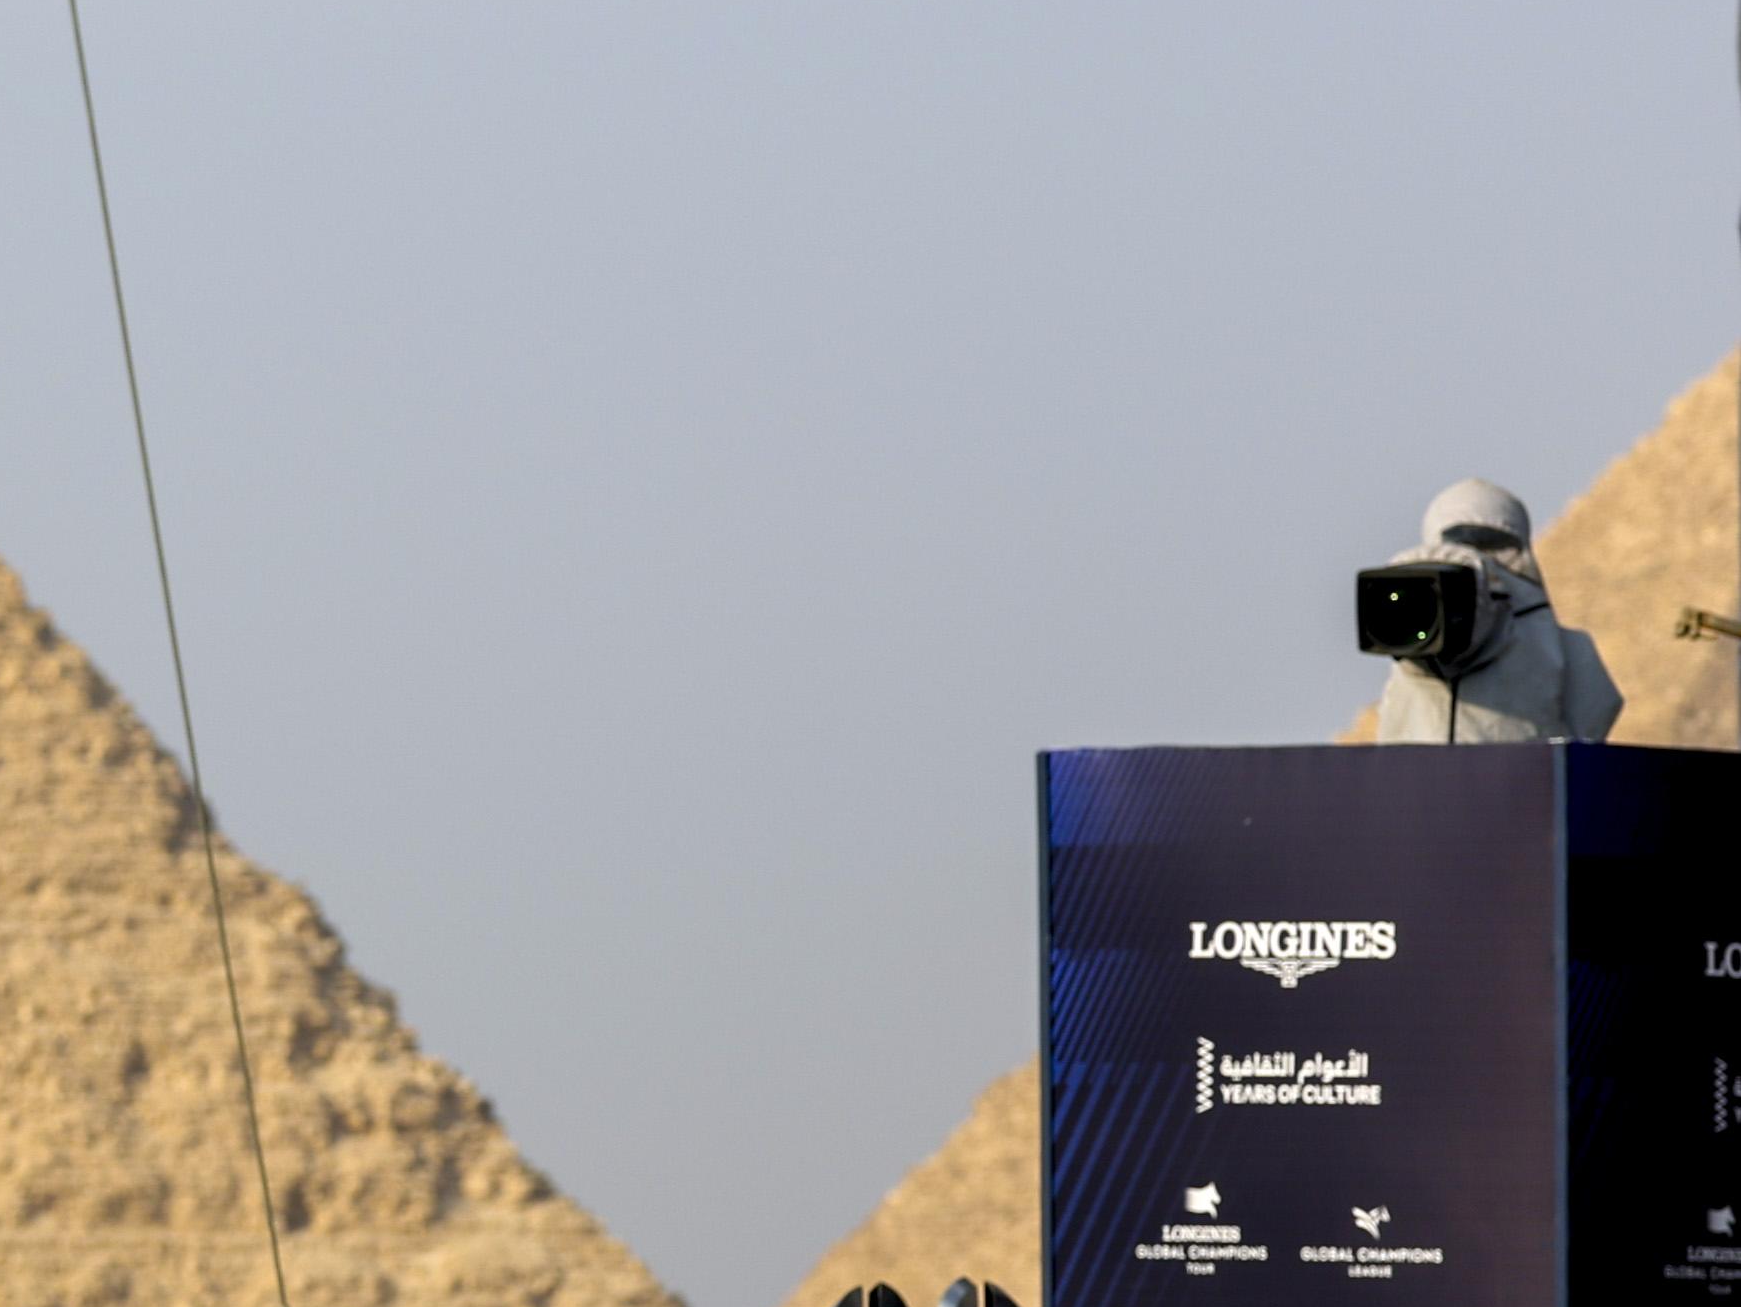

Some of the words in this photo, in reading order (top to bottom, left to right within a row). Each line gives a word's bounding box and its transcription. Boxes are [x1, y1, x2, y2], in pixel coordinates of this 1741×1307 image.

[1189, 921, 1396, 959] LONGINES
[1220, 1084, 1277, 1105] YEARS
[1277, 1084, 1302, 1105] OF
[1302, 1084, 1382, 1105] CULTURE
[1135, 1243, 1186, 1260] GLOBAL
[1187, 1244, 1269, 1261] CHAMPIONS
[1299, 1245, 1355, 1262] GLOBAL
[1356, 1246, 1444, 1264] CHAMPIONS
